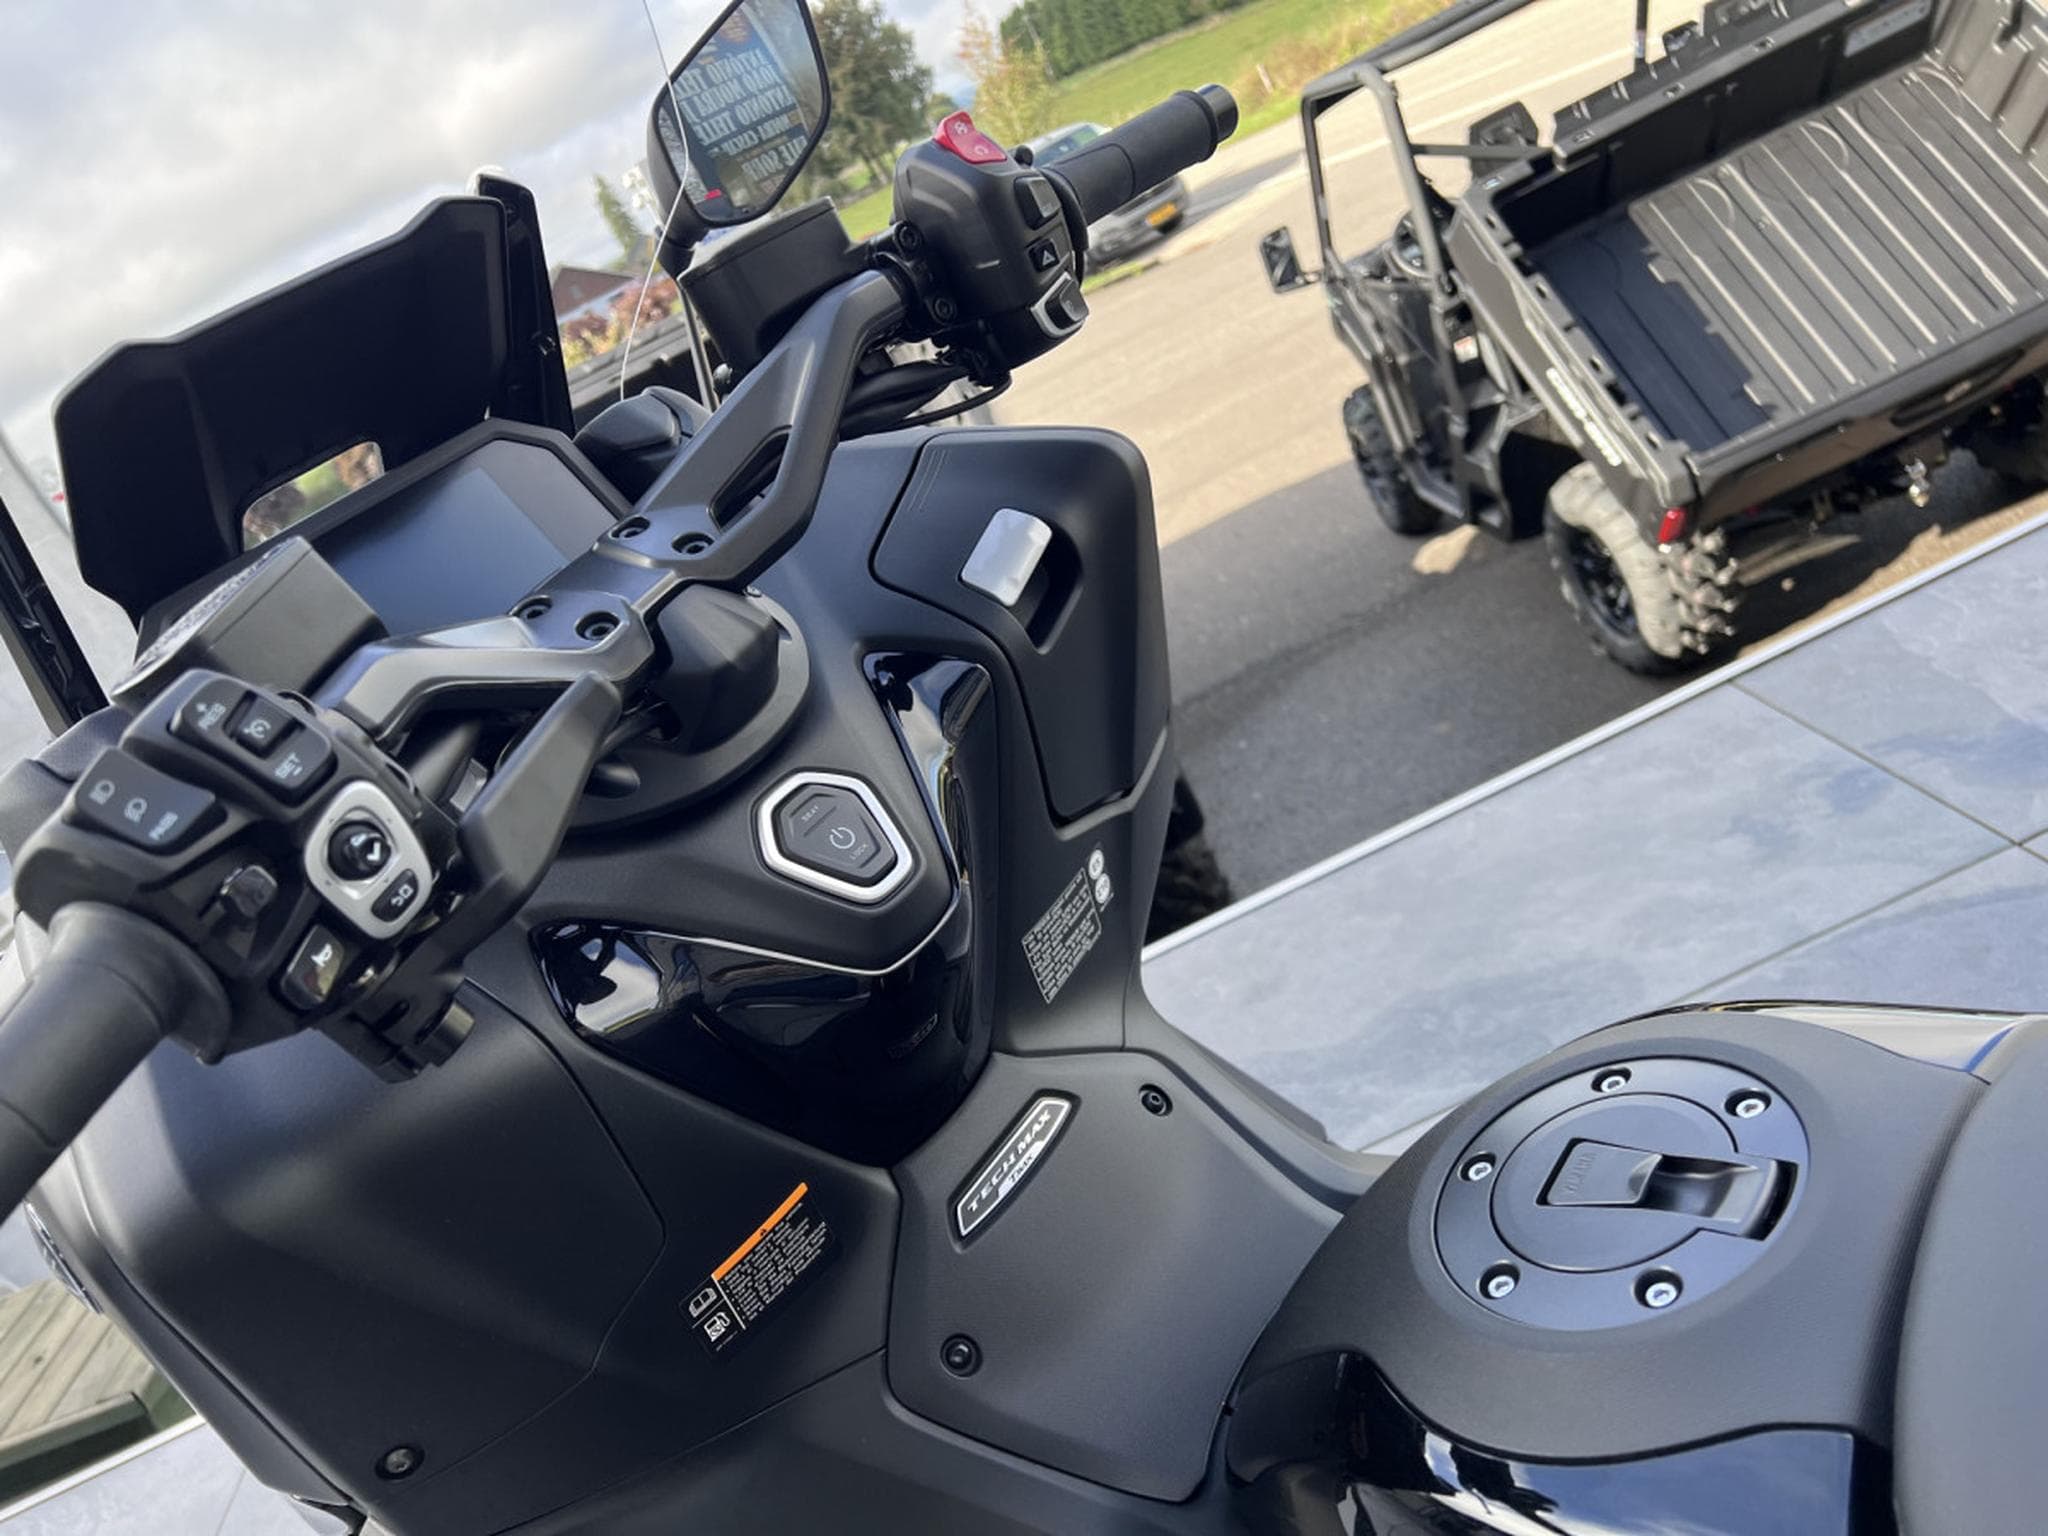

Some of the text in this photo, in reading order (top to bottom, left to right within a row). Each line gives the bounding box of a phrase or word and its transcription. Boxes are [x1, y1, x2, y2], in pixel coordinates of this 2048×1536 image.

[274, 751, 301, 779] SET
[967, 1108, 1052, 1212] TECH MAX
